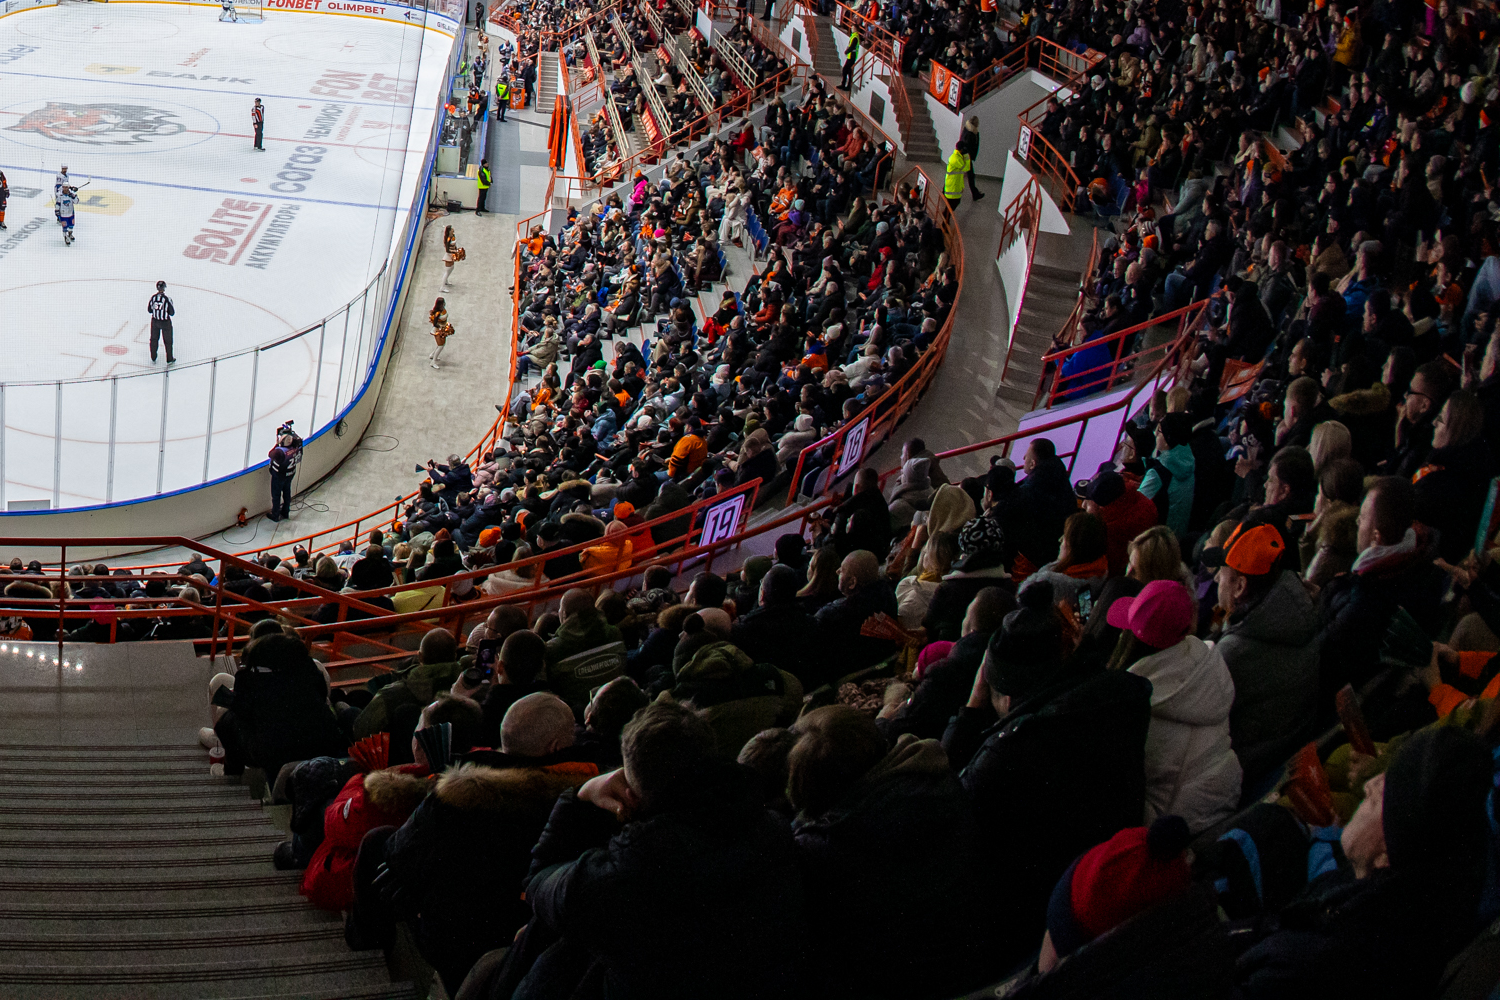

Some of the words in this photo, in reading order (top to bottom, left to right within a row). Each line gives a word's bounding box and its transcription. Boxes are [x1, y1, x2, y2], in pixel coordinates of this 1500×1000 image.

[327, 2, 386, 15] OLIMPBET
[146, 70, 256, 84] БАНК
[309, 68, 367, 99] FON
[361, 72, 417, 104] BET
[182, 198, 262, 263] SOLITE
[245, 203, 303, 270] АККУМУЛЯТОРЫ
[153, 301, 163, 310] 67
[848, 428, 863, 462] 18
[711, 504, 736, 541] 19
